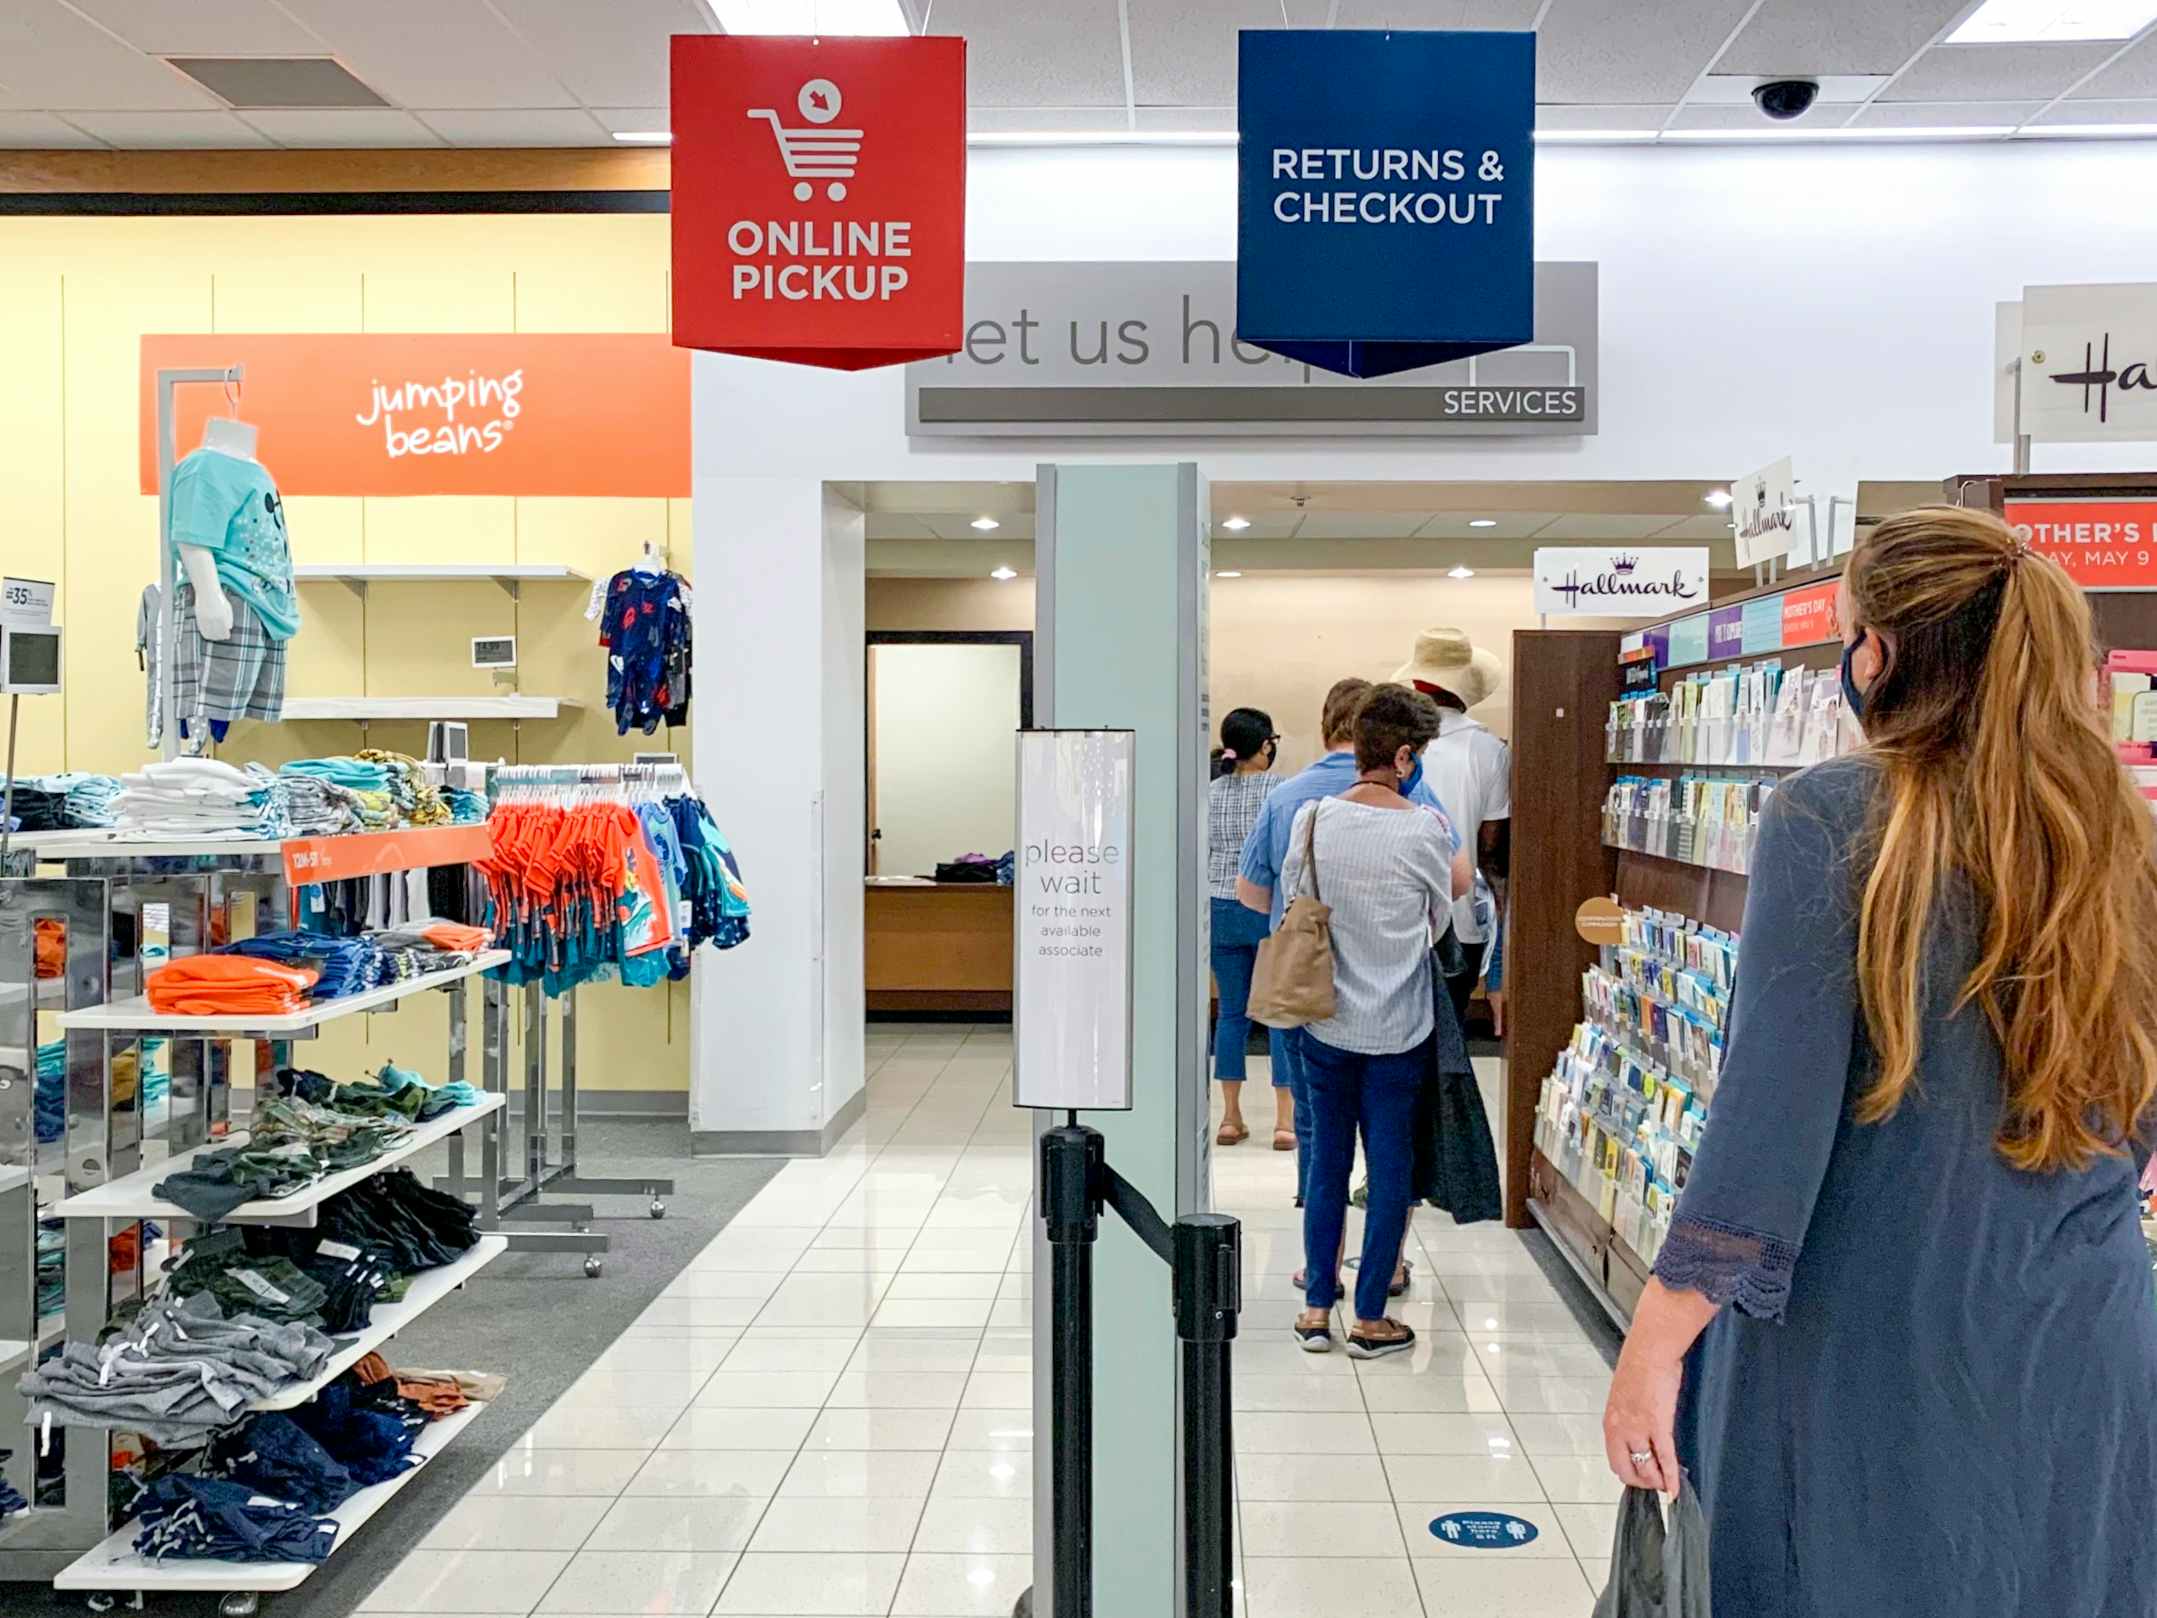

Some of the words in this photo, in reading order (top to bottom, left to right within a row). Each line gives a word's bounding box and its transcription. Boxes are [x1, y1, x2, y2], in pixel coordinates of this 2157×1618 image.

[1272, 149, 1465, 181] RETURNS
[1478, 149, 1505, 182] &
[1273, 192, 1502, 225] CHECKOUT
[727, 220, 912, 257] ONLINE
[732, 264, 909, 301] PICKUP
[946, 308, 1040, 366] et
[1069, 320, 1149, 366] us
[355, 368, 523, 426] jumping
[1443, 390, 1578, 415] SERVICES
[2015, 523, 2141, 544] OTHER'S
[2085, 551, 2129, 566] MAY
[2137, 550, 2150, 566] 9
[1551, 569, 1698, 609] Hallmark
[1025, 839, 1119, 866] please
[1040, 870, 1102, 895] wait
[1032, 905, 1050, 917] for
[1054, 905, 1077, 917] the
[1080, 905, 1112, 918] next
[1041, 925, 1101, 937] available
[1038, 944, 1103, 957] associate
